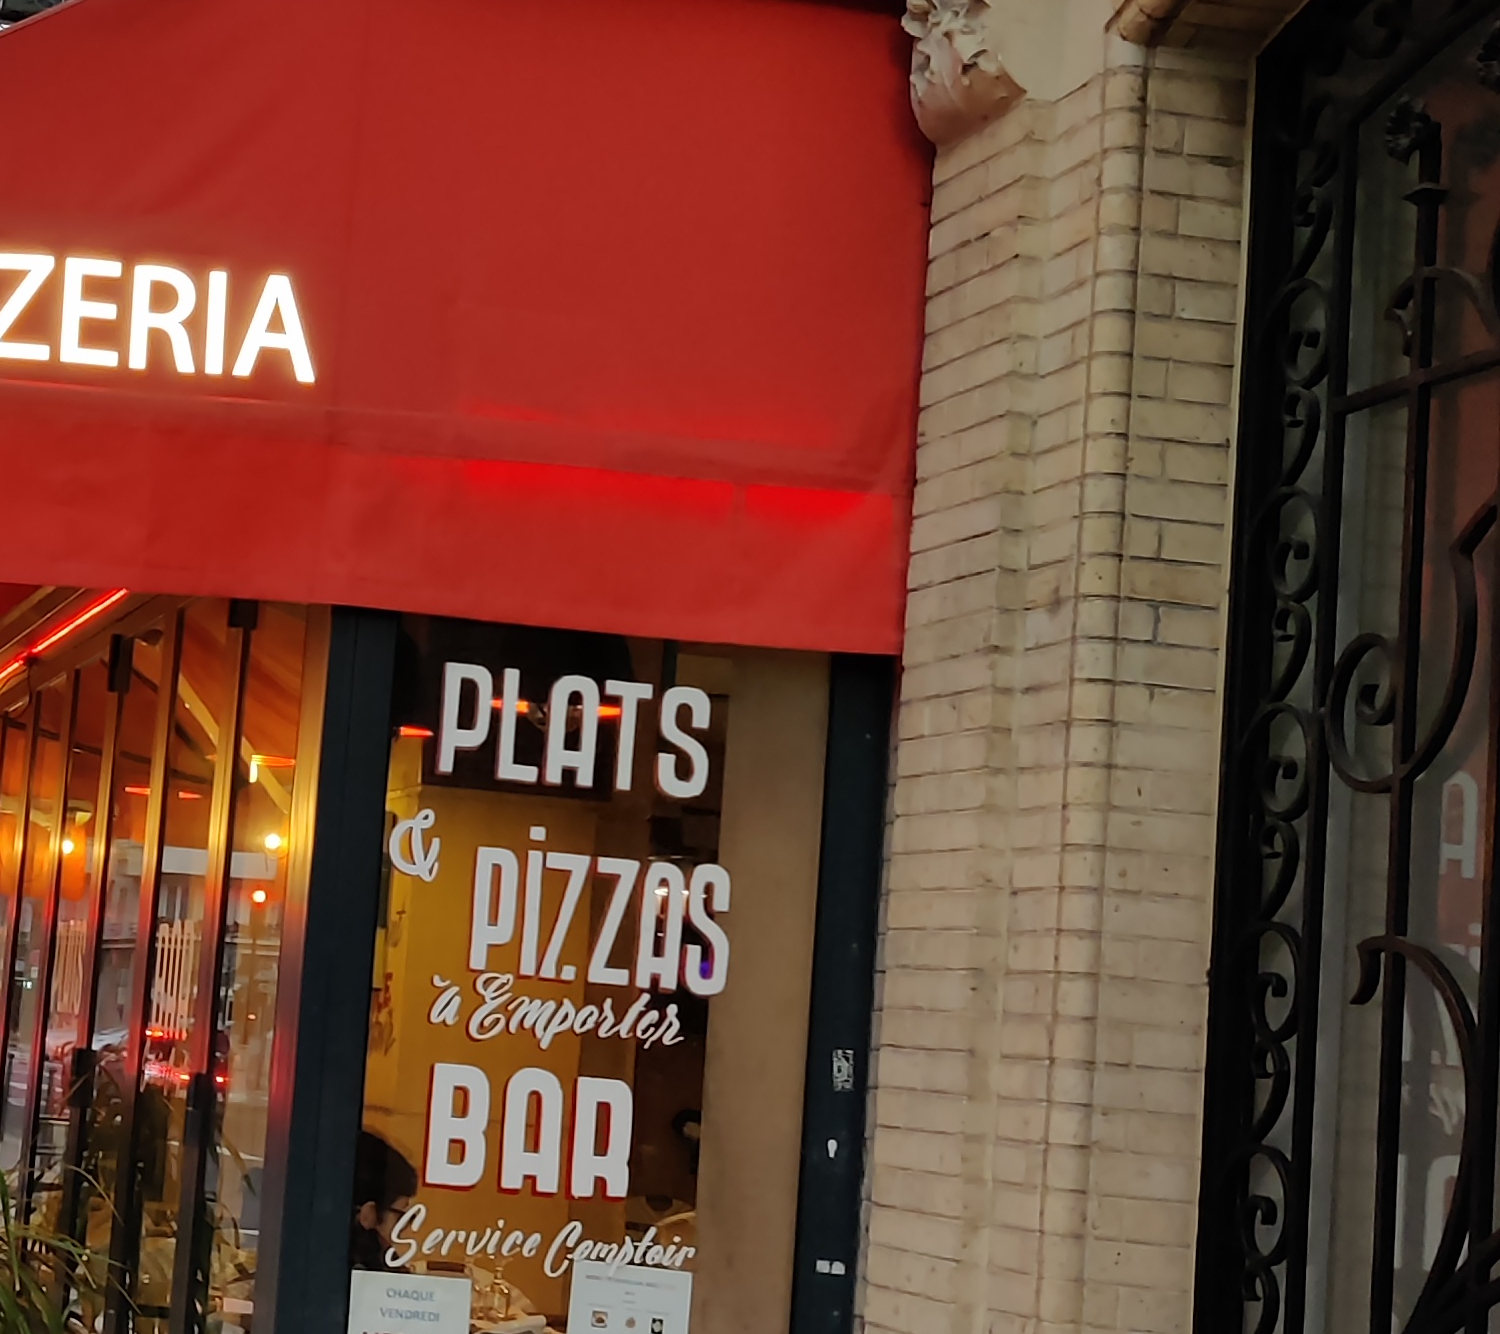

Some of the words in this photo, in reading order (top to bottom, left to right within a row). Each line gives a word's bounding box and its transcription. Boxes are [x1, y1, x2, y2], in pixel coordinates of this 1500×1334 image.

[435, 661, 712, 799] PLATS
[388, 807, 441, 883] &
[467, 970, 686, 1050] Emporter
[423, 1062, 635, 1200] BAR
[385, 1204, 542, 1268] Service
[543, 1220, 697, 1279] Comptoir
[379, 1306, 441, 1324] VENDREDI
[385, 1286, 437, 1304] CHAQUE
